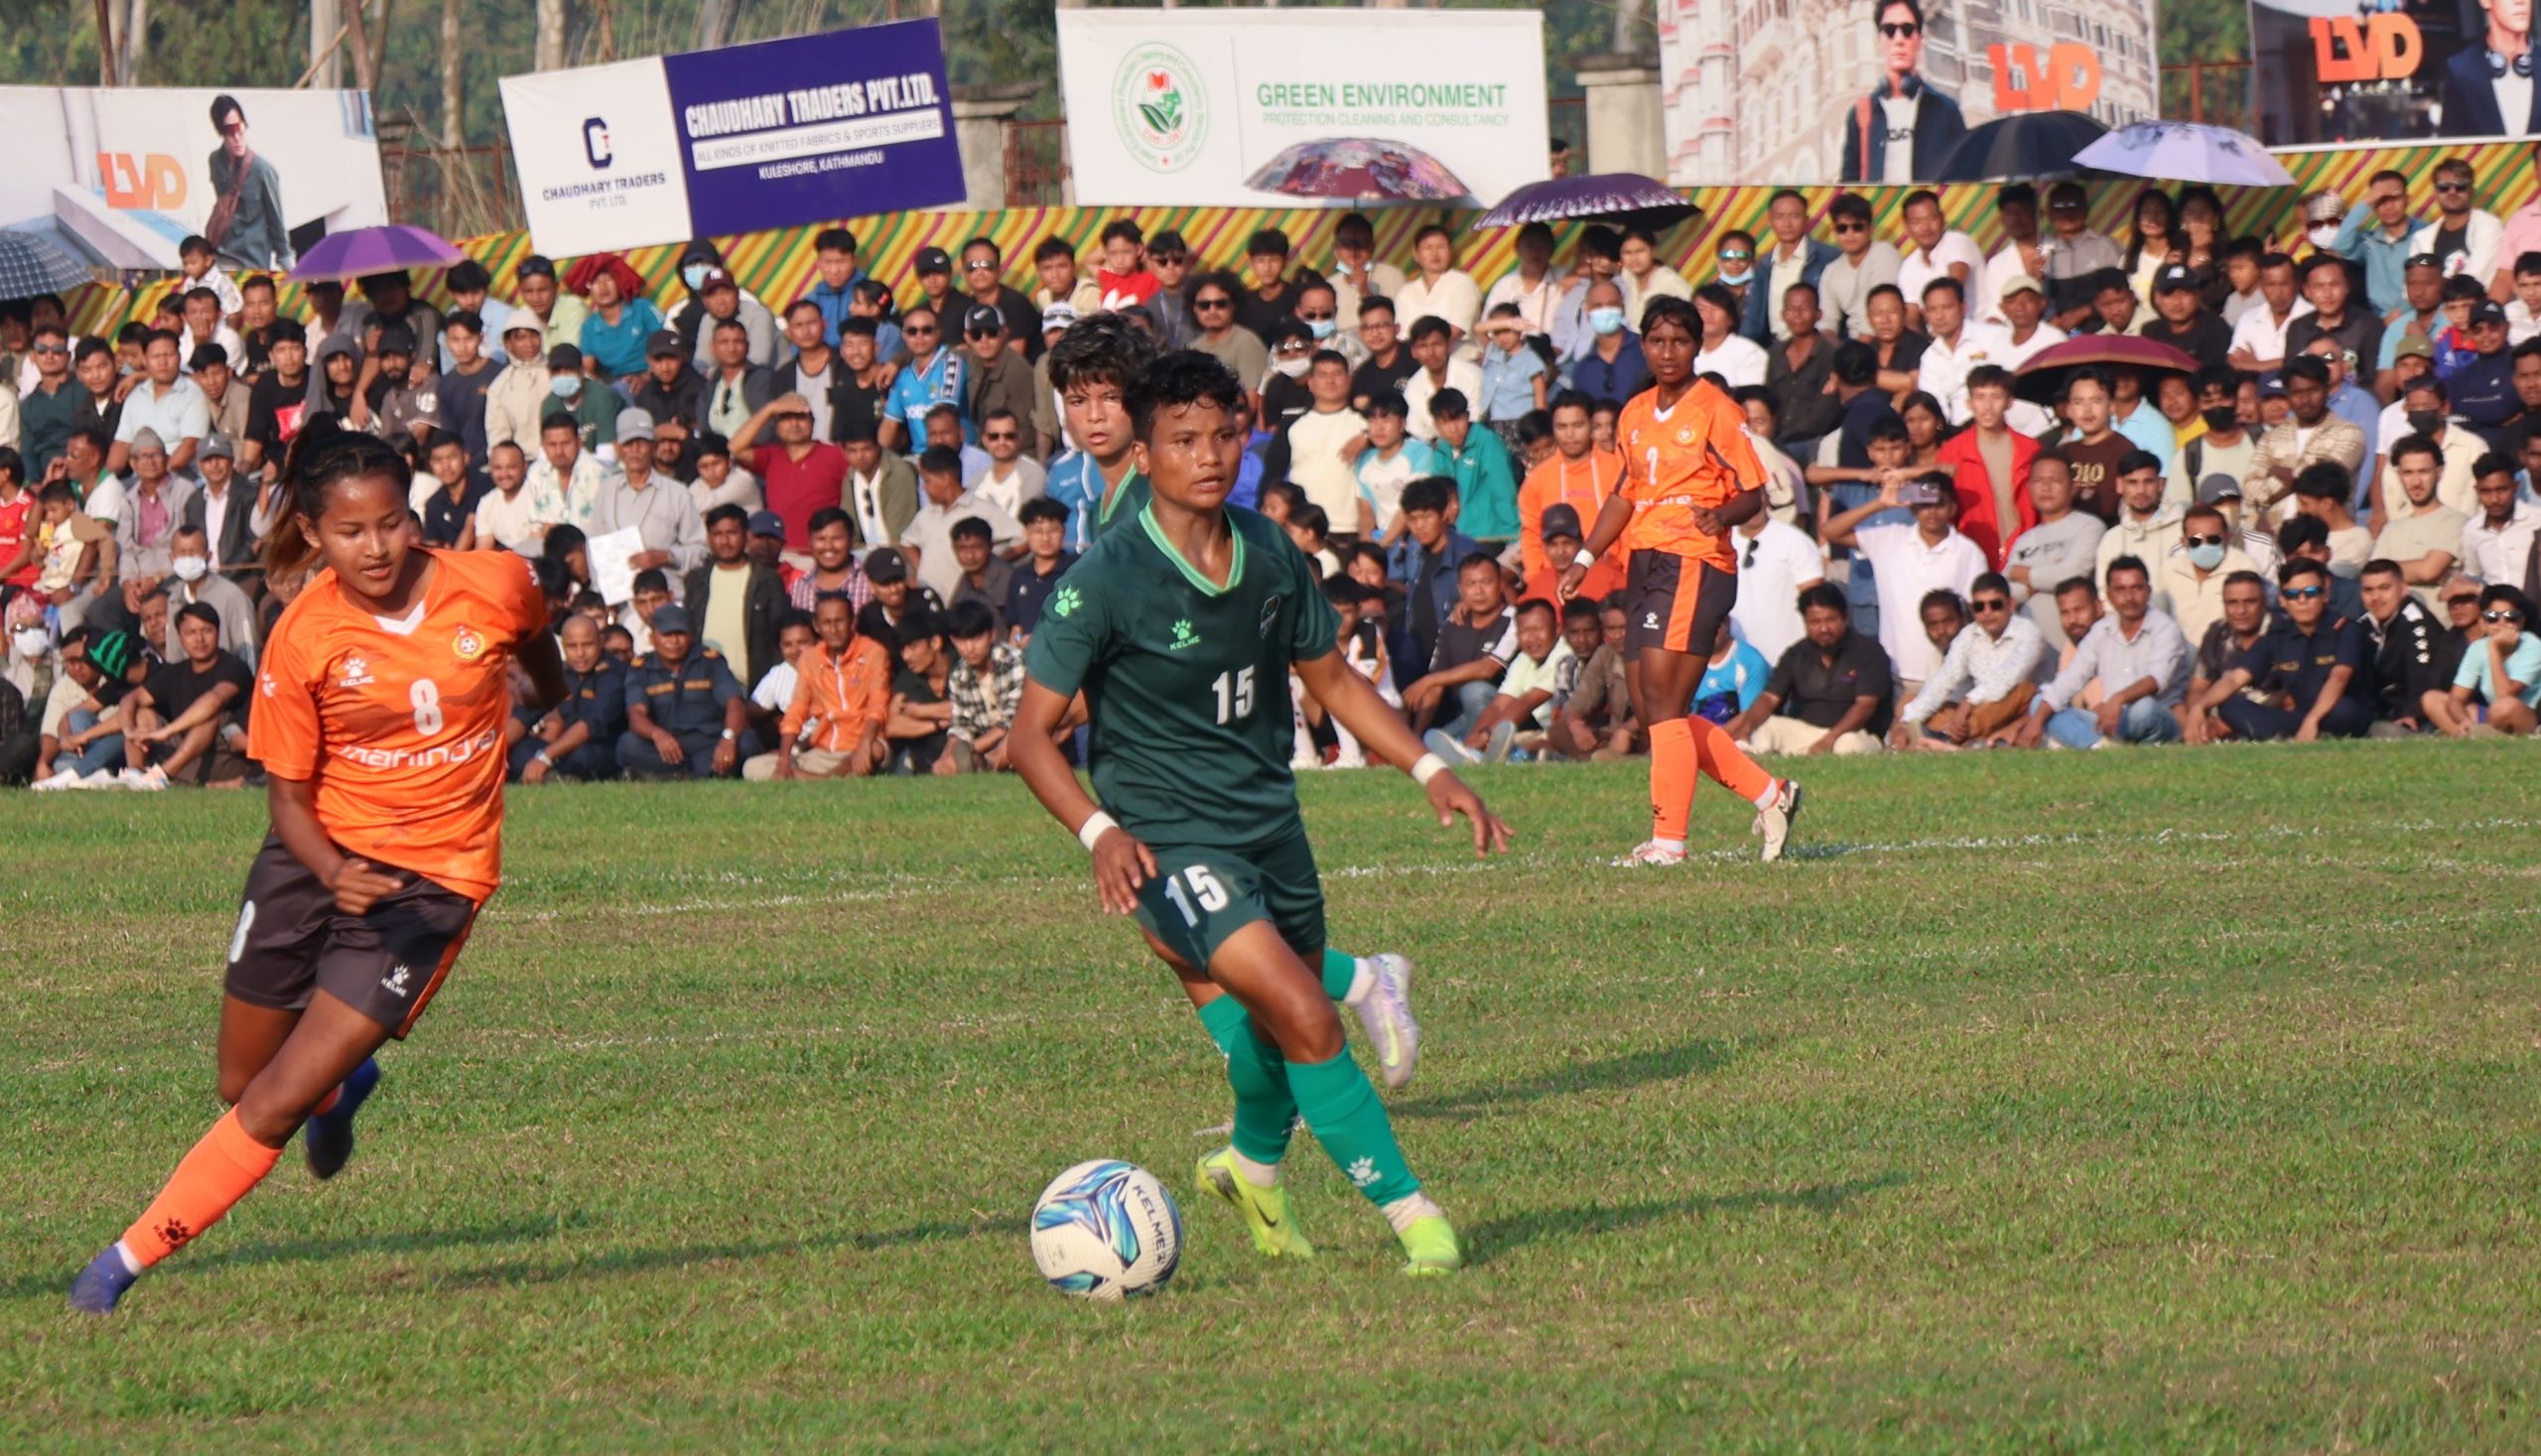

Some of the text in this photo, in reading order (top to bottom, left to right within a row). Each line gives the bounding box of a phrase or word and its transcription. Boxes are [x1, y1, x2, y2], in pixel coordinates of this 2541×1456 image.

[1257, 83, 1507, 107] GREEN ENVIRONMENT
[684, 93, 787, 139] CHAUDHARY
[787, 81, 867, 124] TRADERS
[1263, 113, 1509, 127] PROTECTION CLEANING AND CONSULTANCY
[758, 138, 799, 153] KNITTED
[800, 131, 842, 148] FABRICS
[852, 124, 891, 139] SPORTS
[819, 150, 885, 173] KATHMANDU
[542, 172, 667, 202] CHAUDHARY TRADERS
[1169, 635, 1200, 650] KELME
[409, 678, 444, 735] 8
[1212, 665, 1255, 725] 15
[1164, 864, 1229, 928] 15
[380, 976, 408, 997] KELME
[1133, 1184, 1166, 1251] KELME
